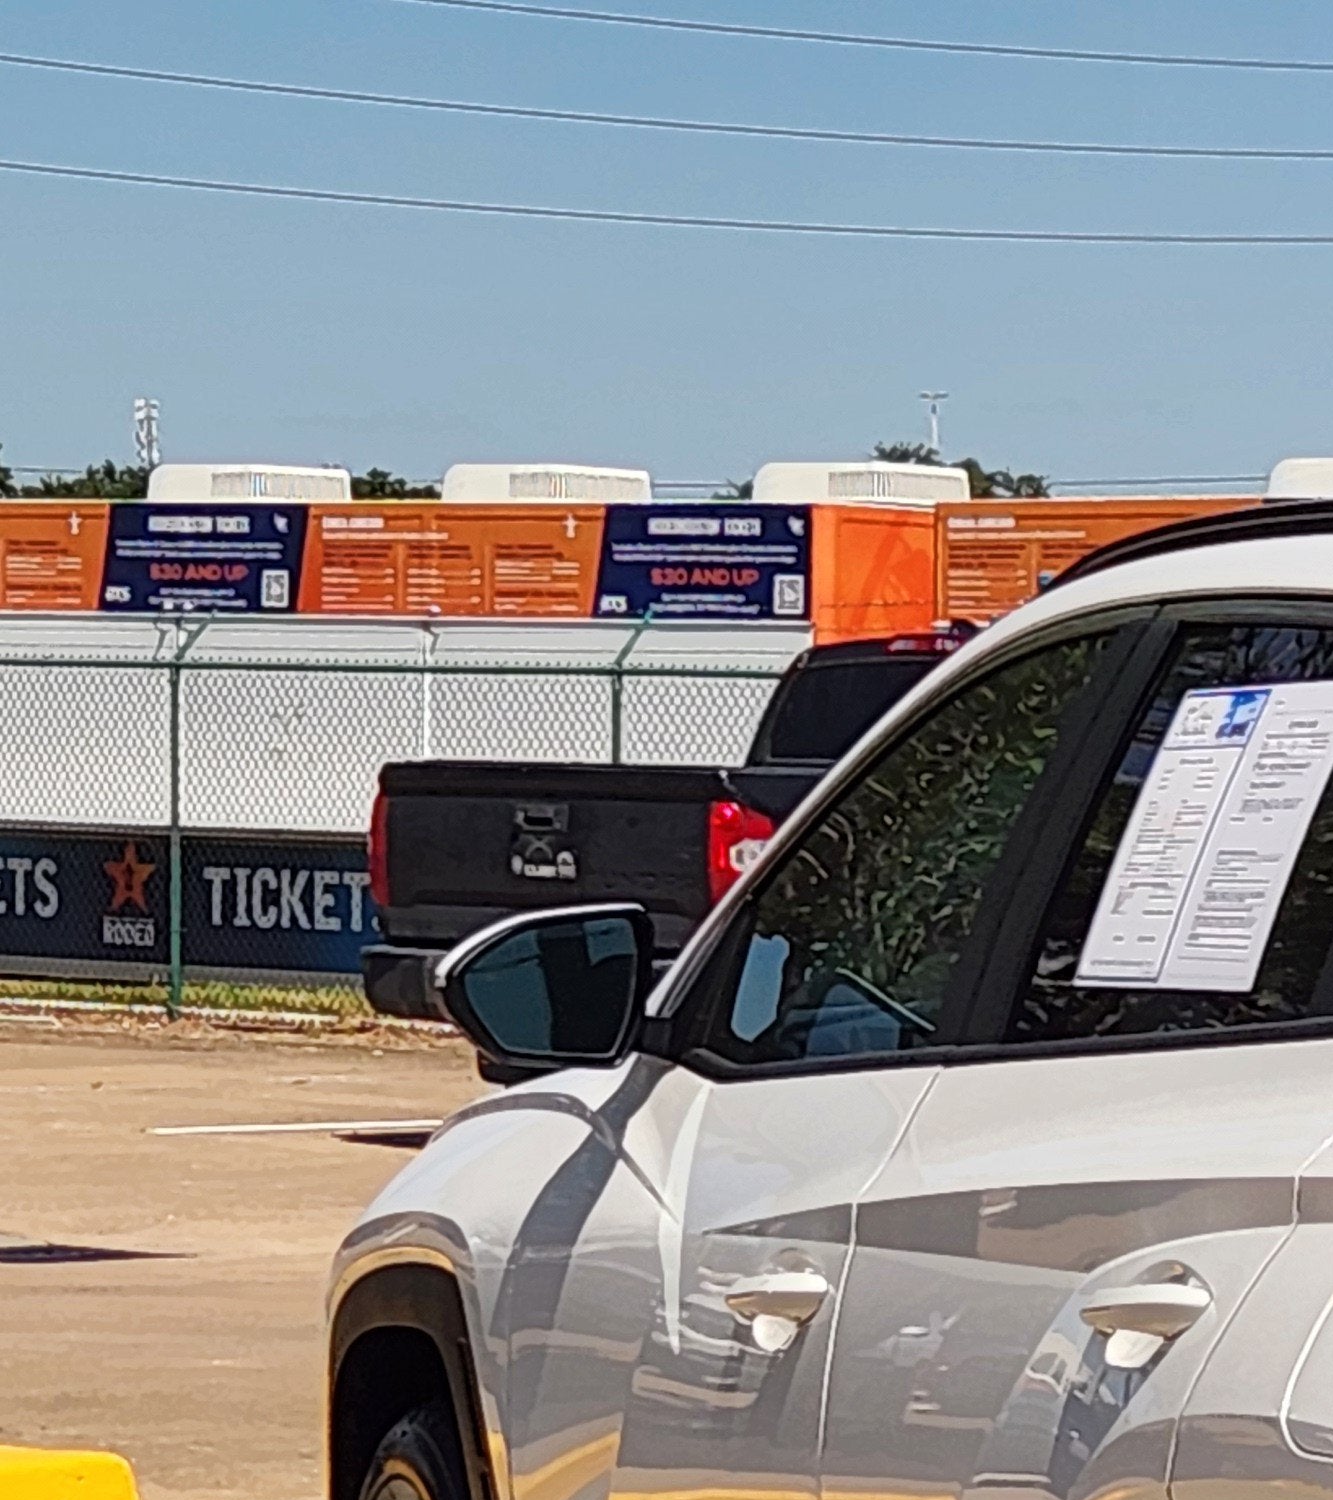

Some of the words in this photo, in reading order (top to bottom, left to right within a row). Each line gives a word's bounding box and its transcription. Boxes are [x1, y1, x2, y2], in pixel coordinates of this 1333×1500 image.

[184, 563, 221, 581] AND
[223, 565, 248, 582] UP
[690, 568, 730, 586] AND
[732, 569, 760, 586] UP
[0, 857, 59, 918] TS
[202, 867, 382, 932] TICKET
